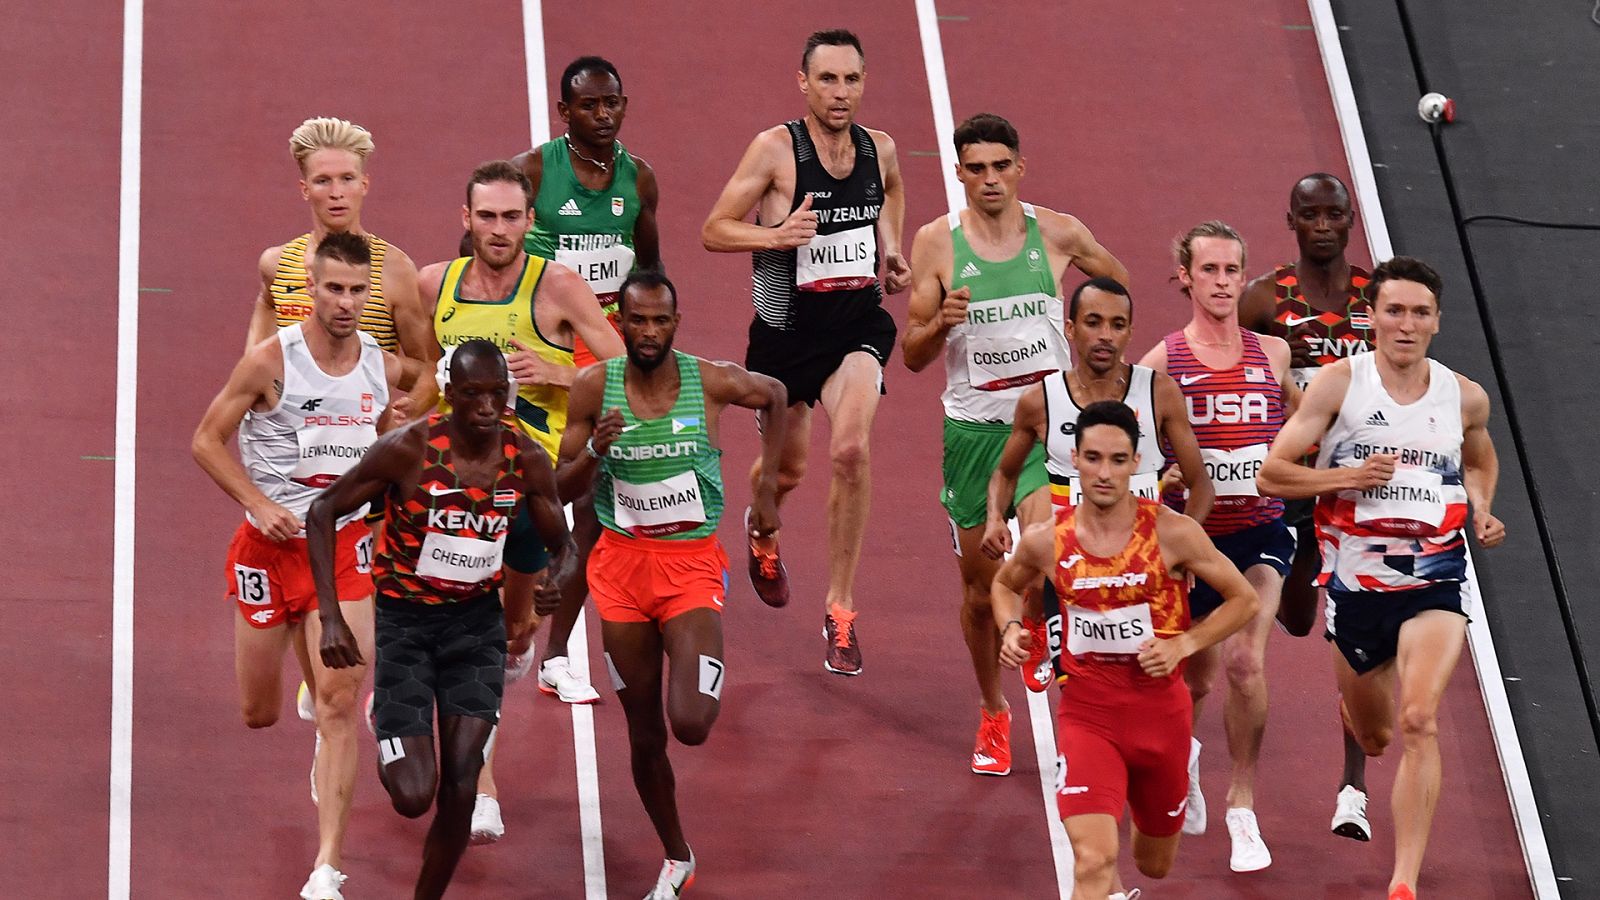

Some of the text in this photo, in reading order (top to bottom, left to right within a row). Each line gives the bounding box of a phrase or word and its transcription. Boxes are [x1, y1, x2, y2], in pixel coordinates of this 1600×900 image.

[812, 209, 831, 224] EW
[559, 234, 622, 250] ETHIOPIA
[578, 259, 618, 281] LEMI
[968, 300, 1047, 325] IRELAND
[973, 338, 1047, 365] COSCORAN
[1185, 393, 1268, 424] USA
[610, 441, 698, 460] DJIBOUTI
[617, 488, 697, 512] SOULEIMAN
[427, 508, 509, 534] KENYA
[238, 570, 264, 601] 13
[1049, 619, 1062, 652] 5
[1074, 617, 1144, 641] FONTES
[708, 660, 722, 692] 7
